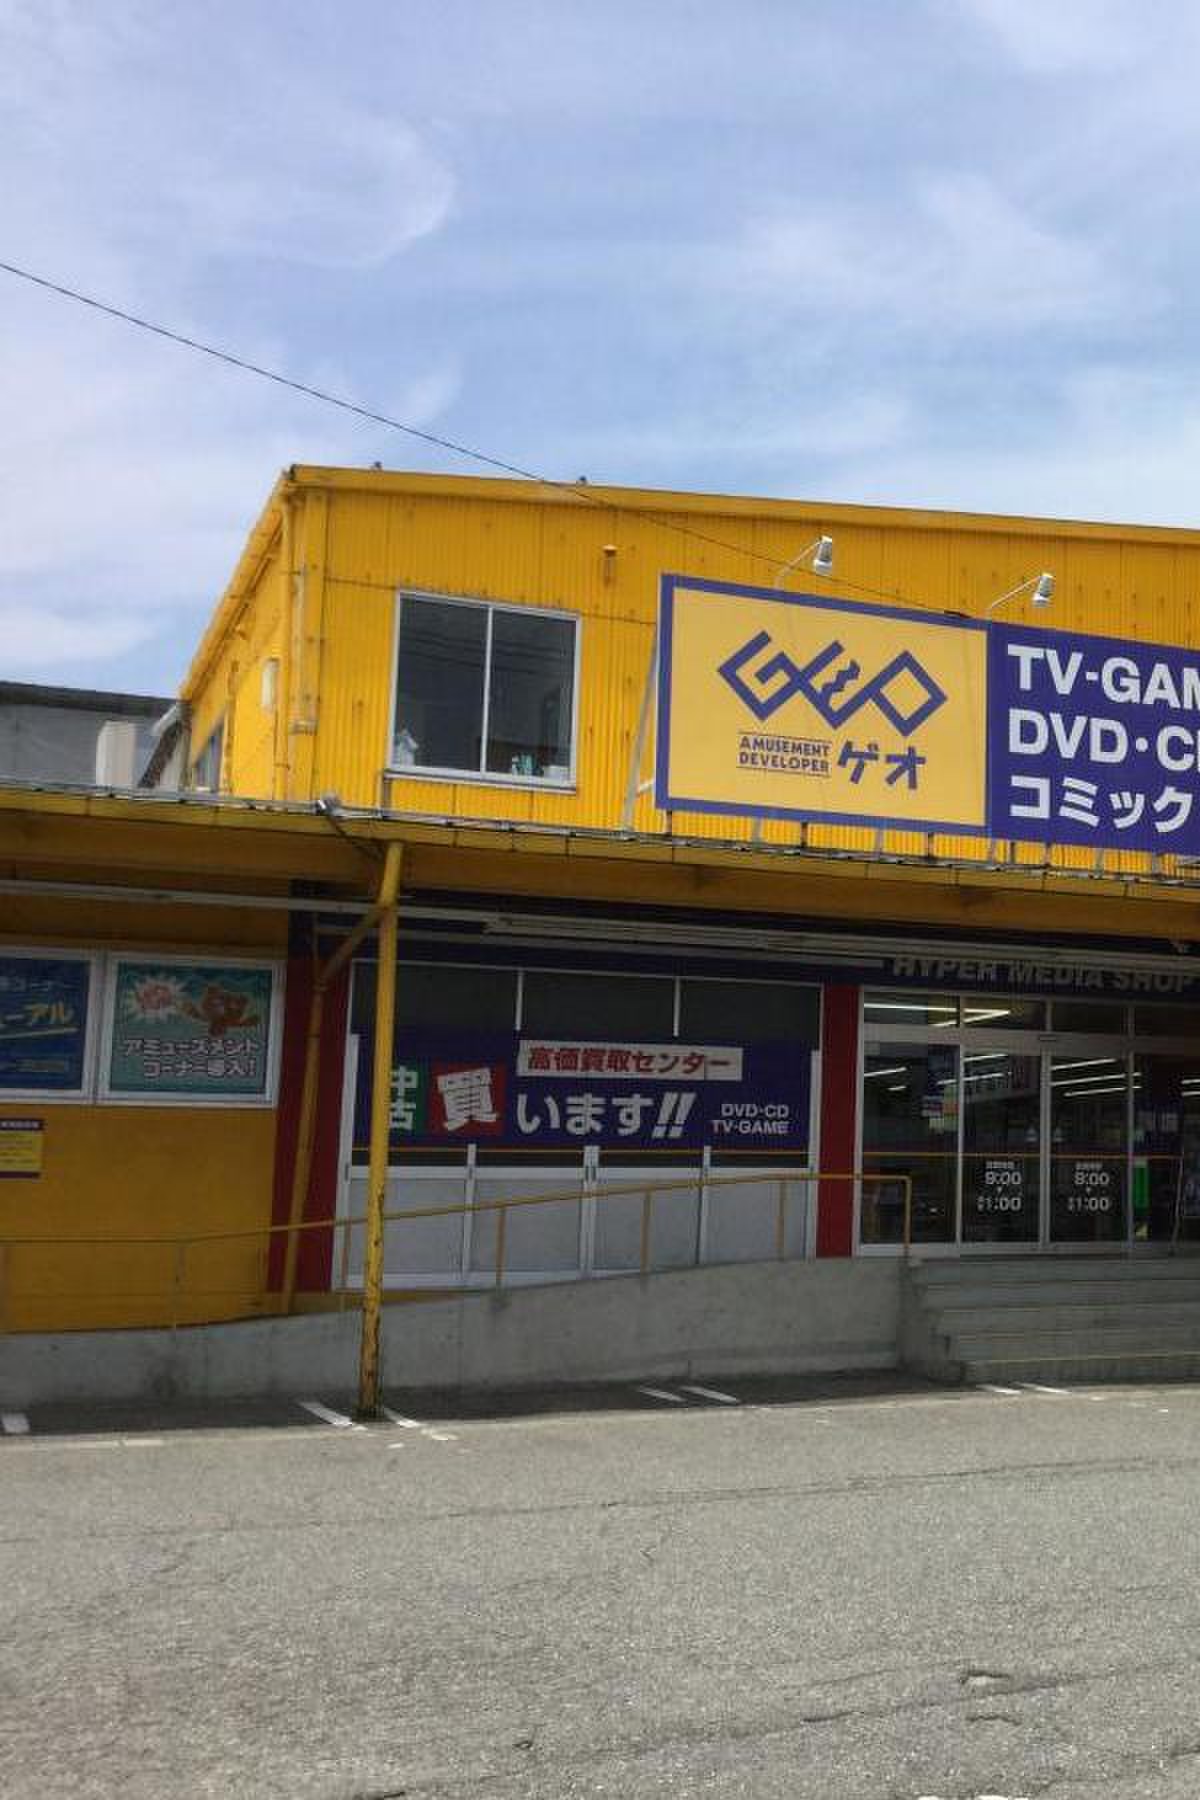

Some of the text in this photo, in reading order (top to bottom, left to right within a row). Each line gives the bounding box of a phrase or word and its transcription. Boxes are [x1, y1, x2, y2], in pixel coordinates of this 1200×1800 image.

[739, 735, 832, 758] AMUSEMENT
[738, 751, 831, 774] DEVELOPER
[837, 739, 927, 790] ゲオ
[1009, 775, 1194, 833] コミック
[893, 957, 1002, 984] HYPER
[1008, 964, 1103, 987] MEDIA
[527, 1046, 730, 1076] 高価買取センター
